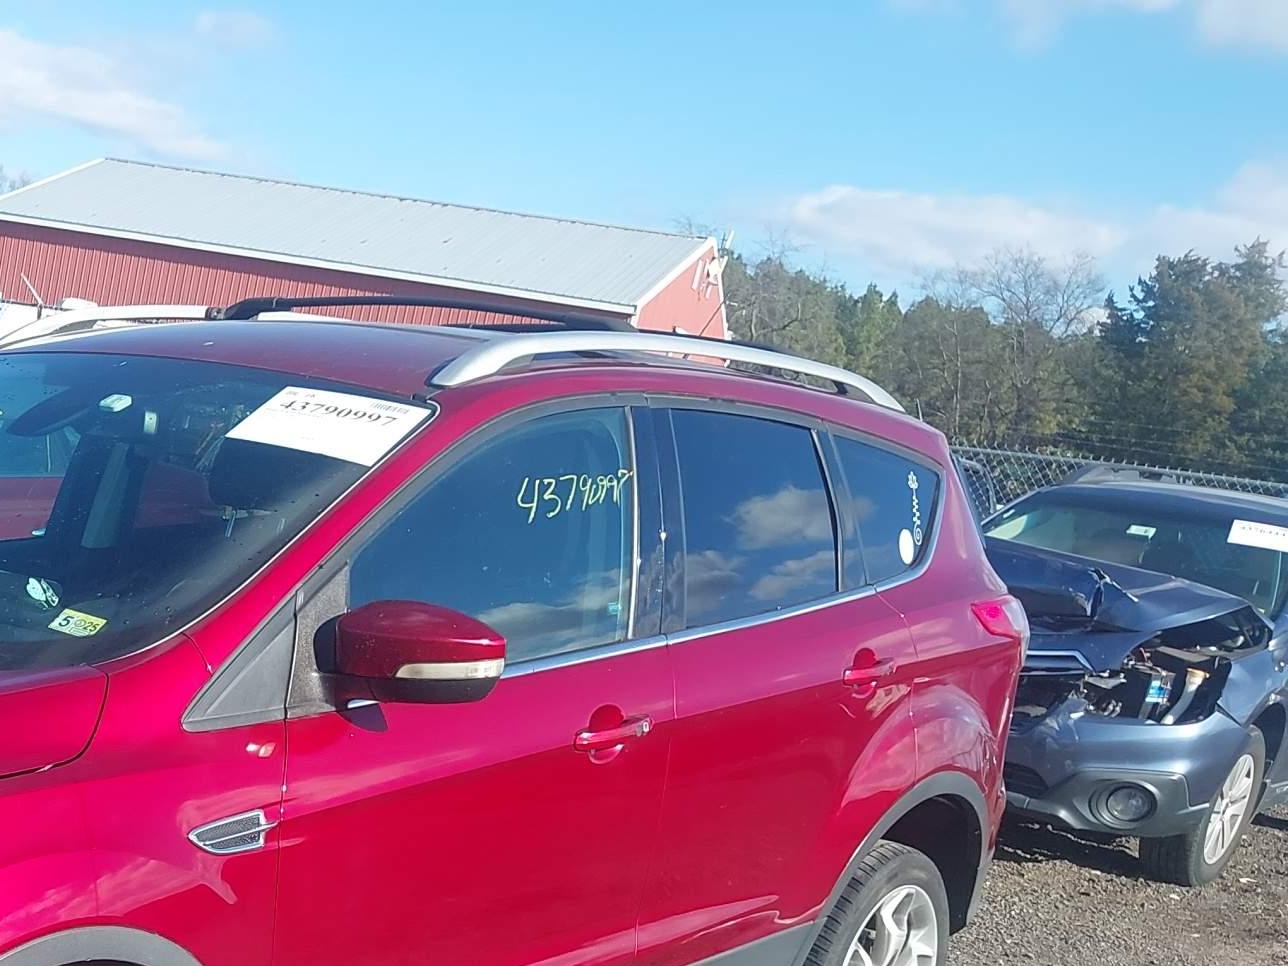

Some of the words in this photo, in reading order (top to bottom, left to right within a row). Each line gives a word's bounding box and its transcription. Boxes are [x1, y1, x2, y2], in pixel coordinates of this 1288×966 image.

[279, 400, 398, 426] 43790997
[58, 615, 75, 627] 5
[82, 621, 100, 632] 25
